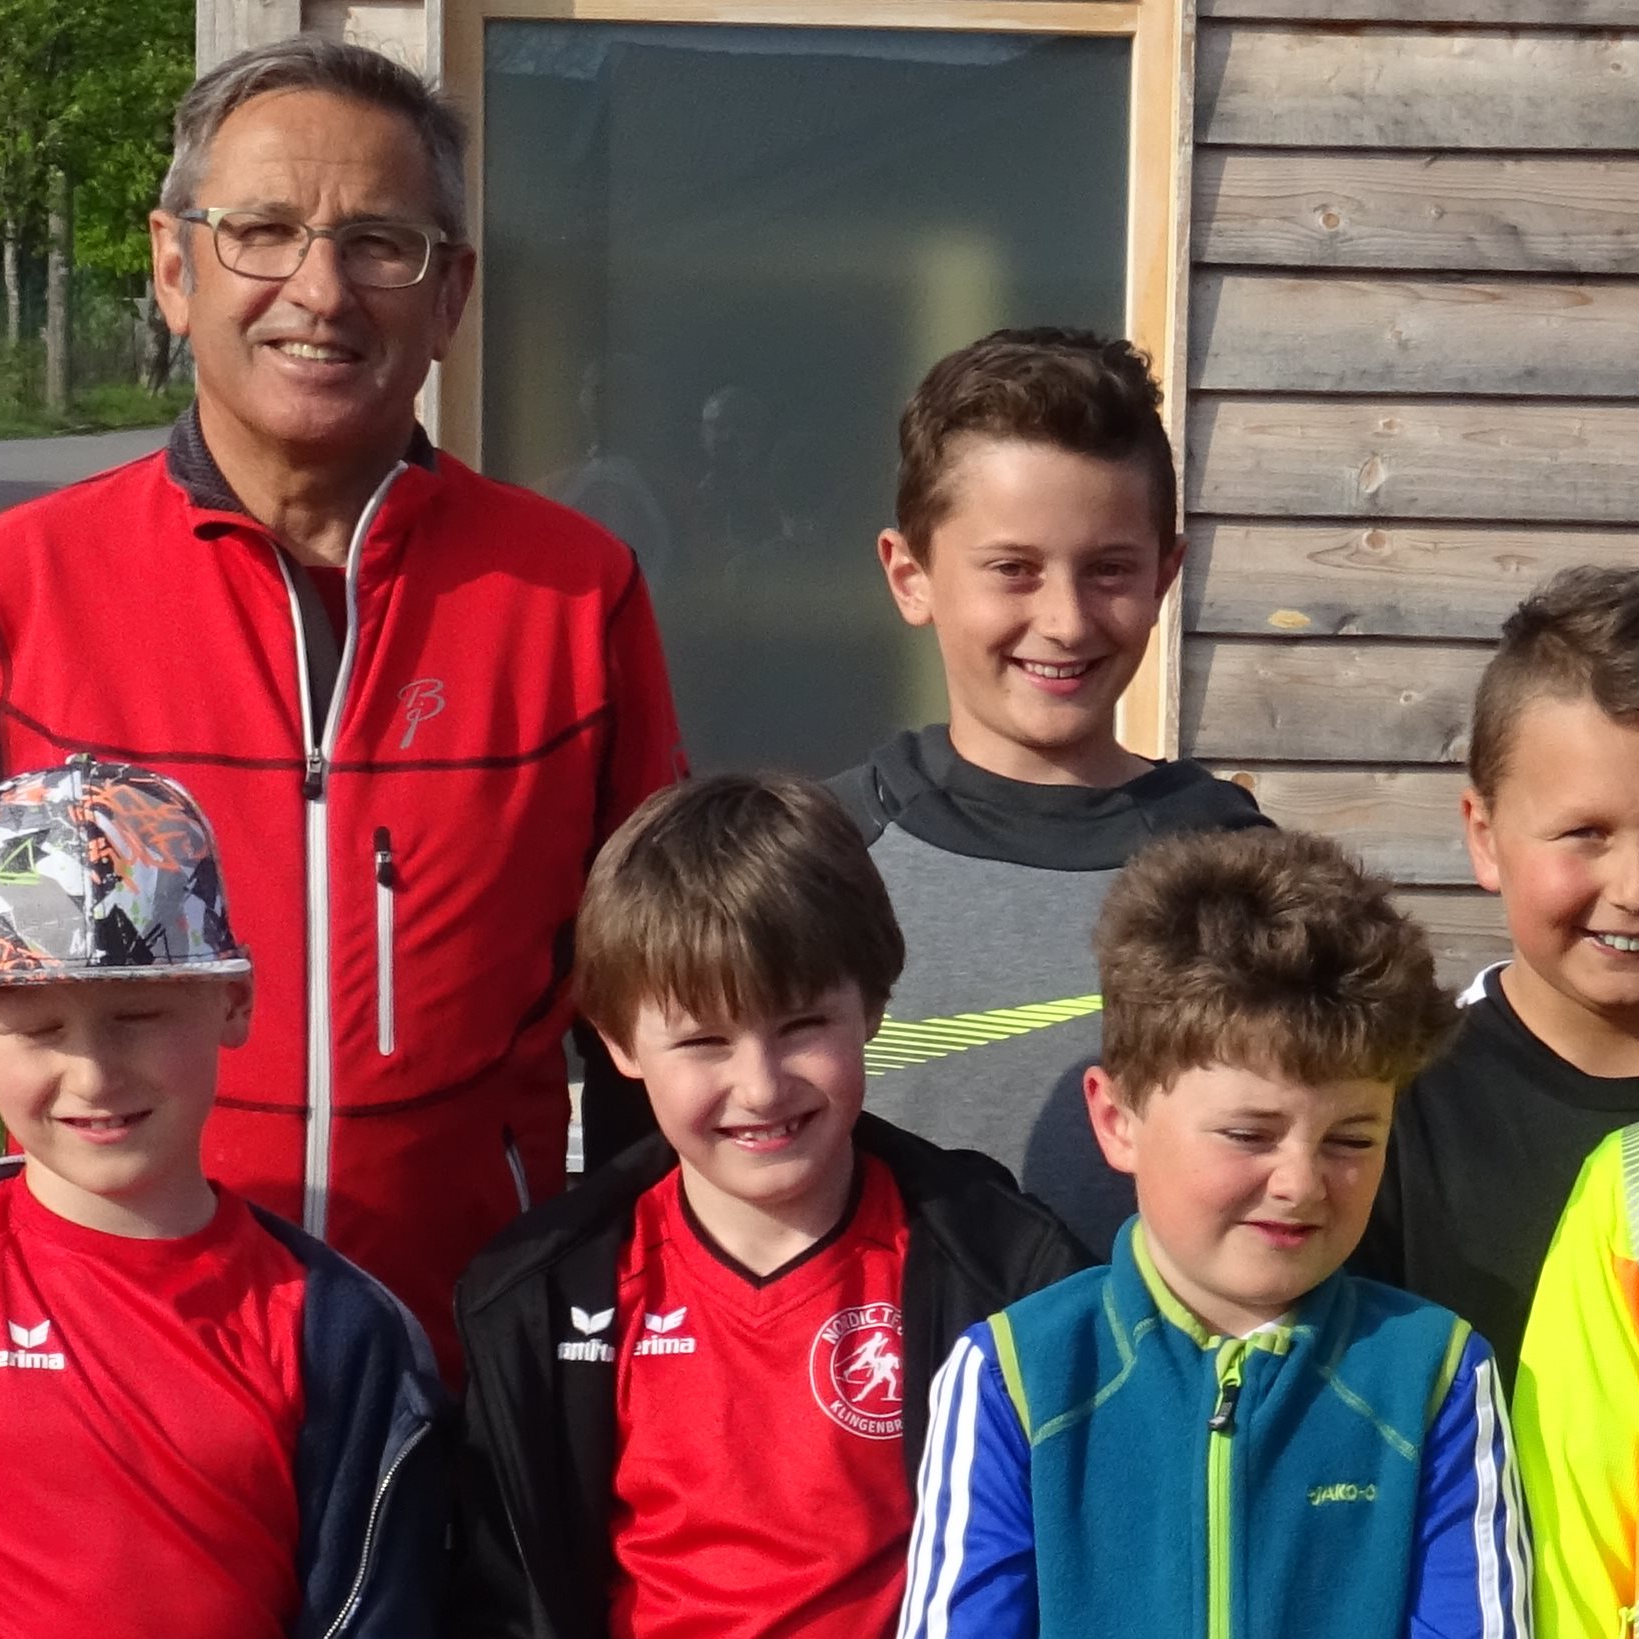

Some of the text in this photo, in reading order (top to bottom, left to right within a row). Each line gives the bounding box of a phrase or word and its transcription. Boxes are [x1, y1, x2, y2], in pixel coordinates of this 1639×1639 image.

[821, 1307, 903, 1346] NORDIC TE
[829, 1400, 904, 1433] KLINGENBR
[1307, 1483, 1376, 1506] JAKO-O
